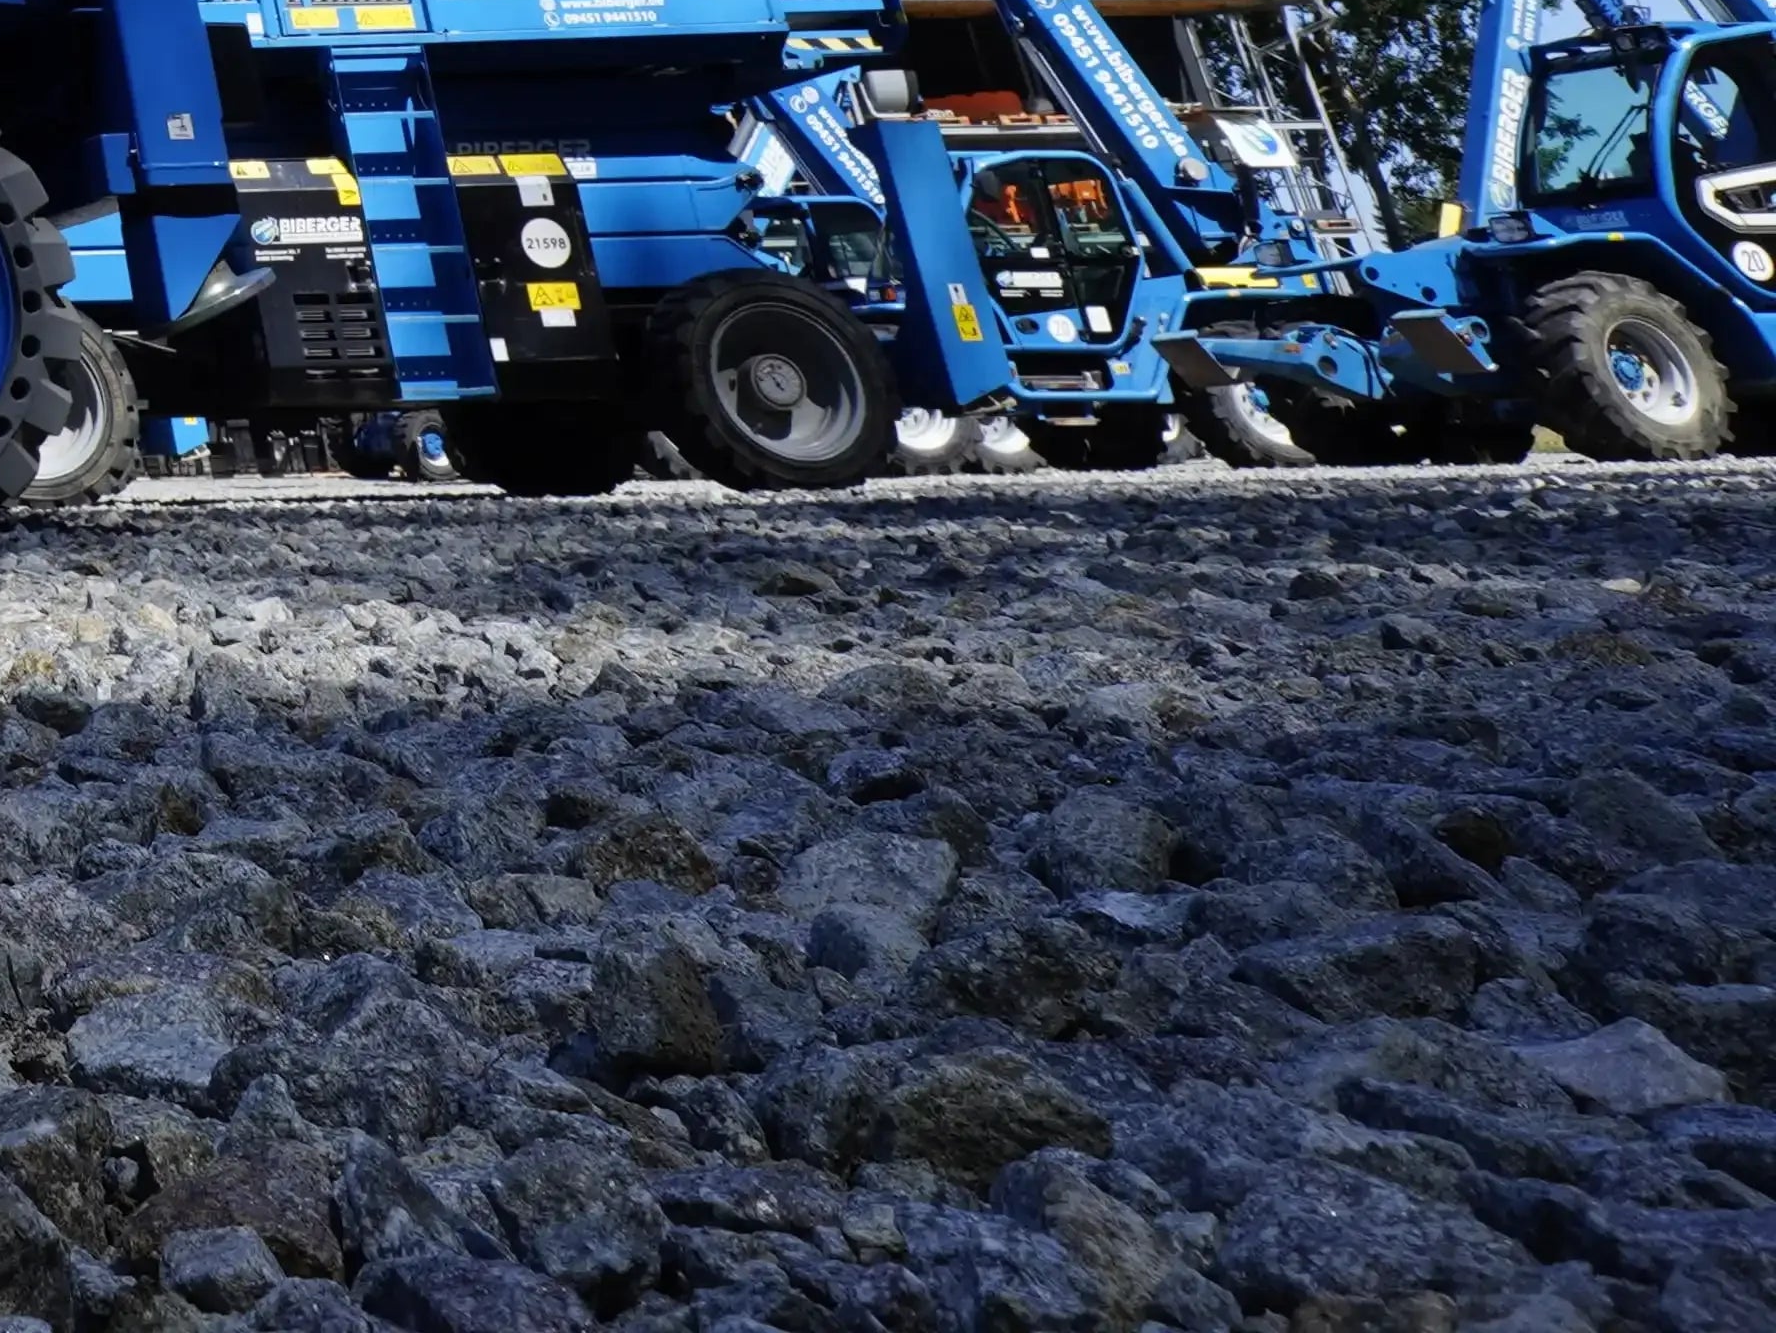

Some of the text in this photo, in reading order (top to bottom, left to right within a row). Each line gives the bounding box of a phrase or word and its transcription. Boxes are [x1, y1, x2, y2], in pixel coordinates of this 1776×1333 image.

[1053, 13, 1159, 149] 09451 9441510
[1072, 5, 1188, 157] www.biberger.de
[1492, 68, 1527, 186] BIBERGER
[279, 217, 360, 232] BIBERGER
[526, 237, 566, 249] 21598
[1742, 250, 1765, 273] 20
